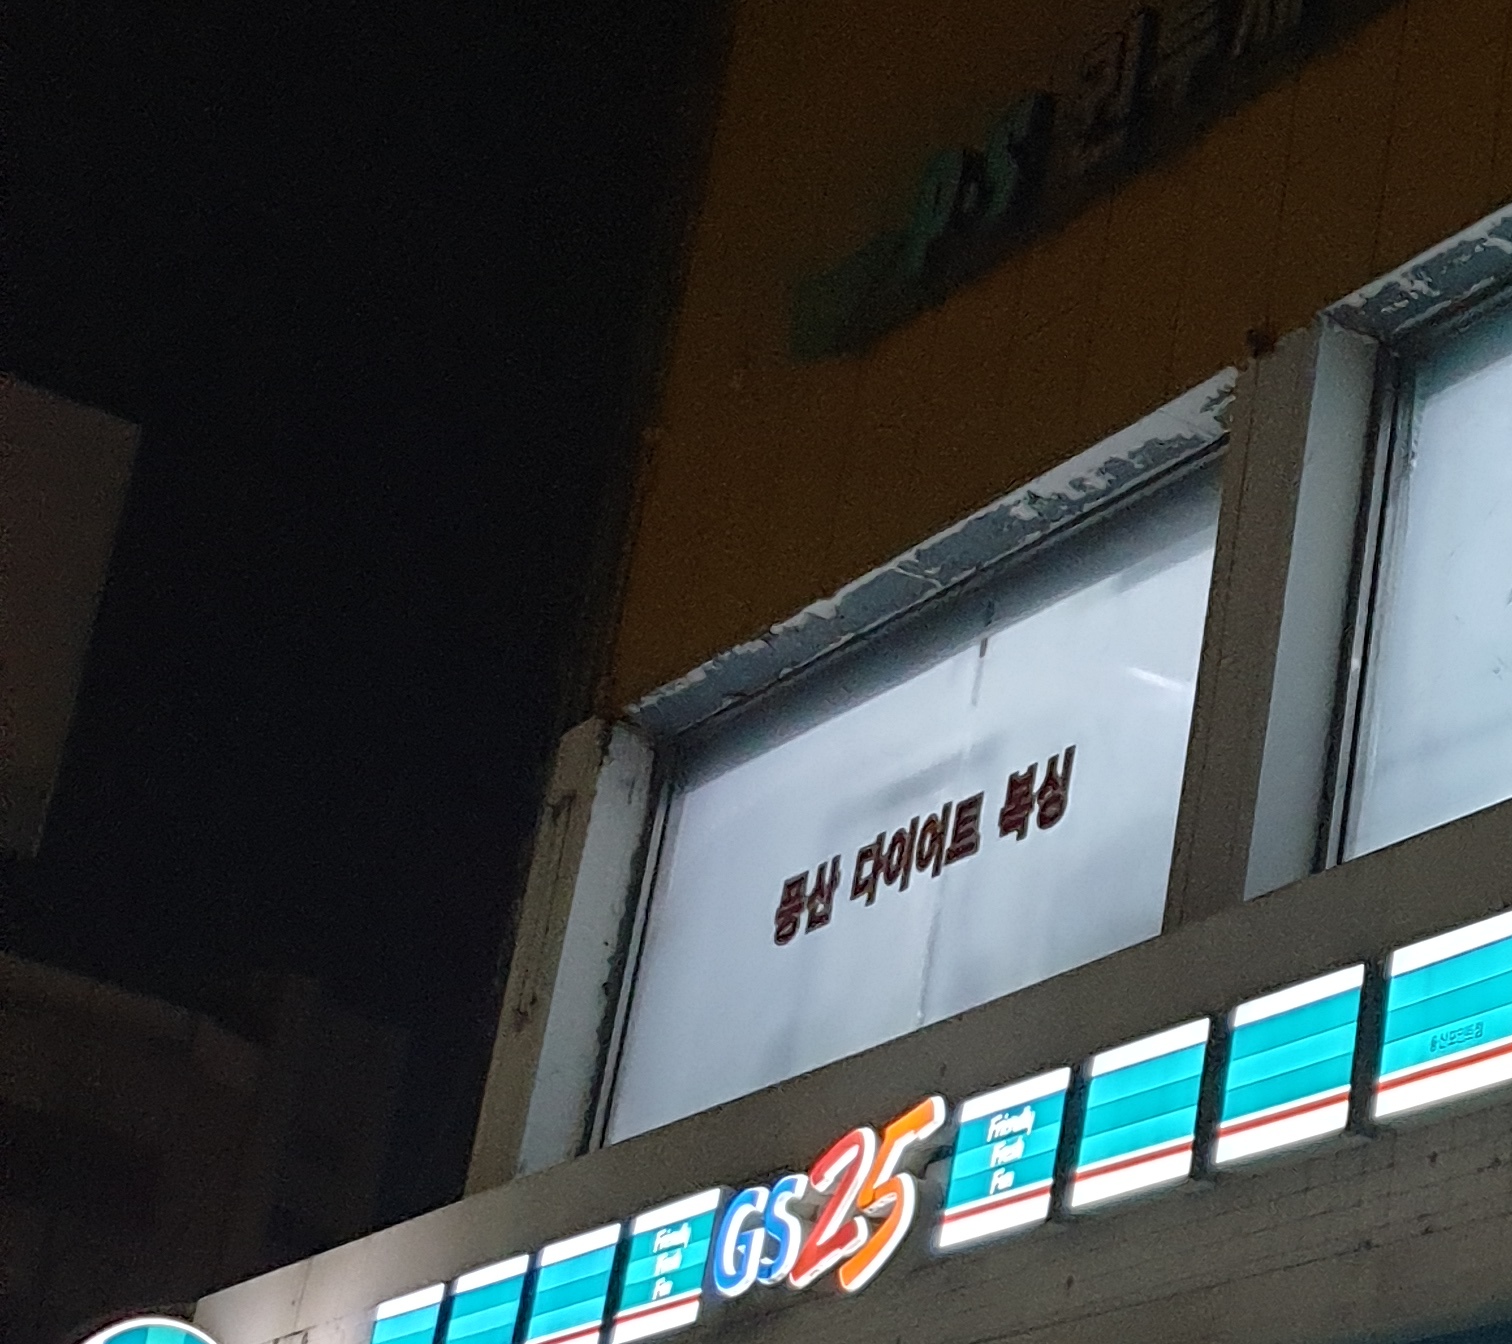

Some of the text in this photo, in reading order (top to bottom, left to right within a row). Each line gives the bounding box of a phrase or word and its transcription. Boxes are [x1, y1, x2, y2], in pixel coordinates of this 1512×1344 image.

[849, 791, 985, 907] 다이어트
[998, 744, 1077, 841] 복싱
[713, 1095, 946, 1299] GS25
